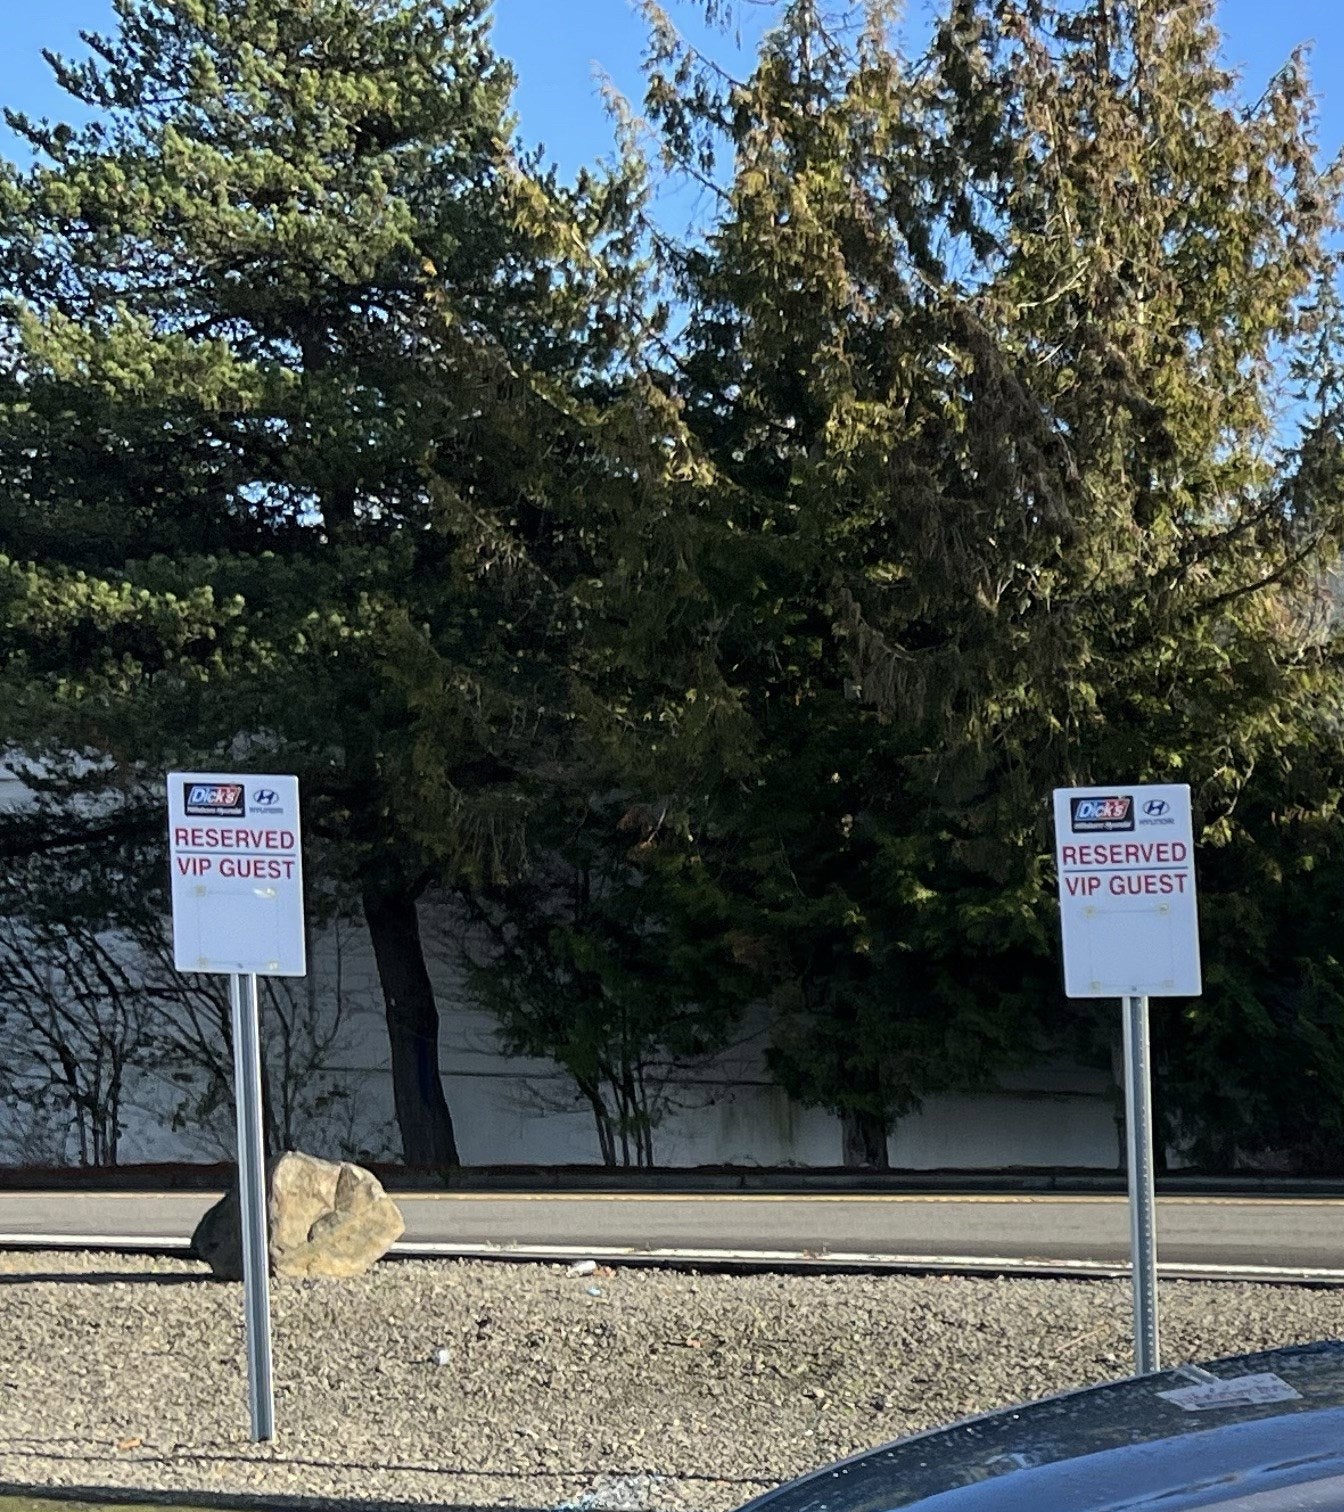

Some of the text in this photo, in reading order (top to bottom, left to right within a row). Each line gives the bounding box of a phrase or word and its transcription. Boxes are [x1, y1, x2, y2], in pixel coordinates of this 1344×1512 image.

[175, 828, 295, 850] RESERVED
[1062, 842, 1188, 865] RESERVED
[177, 856, 296, 880] VIP GUEST
[1065, 873, 1188, 896] VIP GUEST
